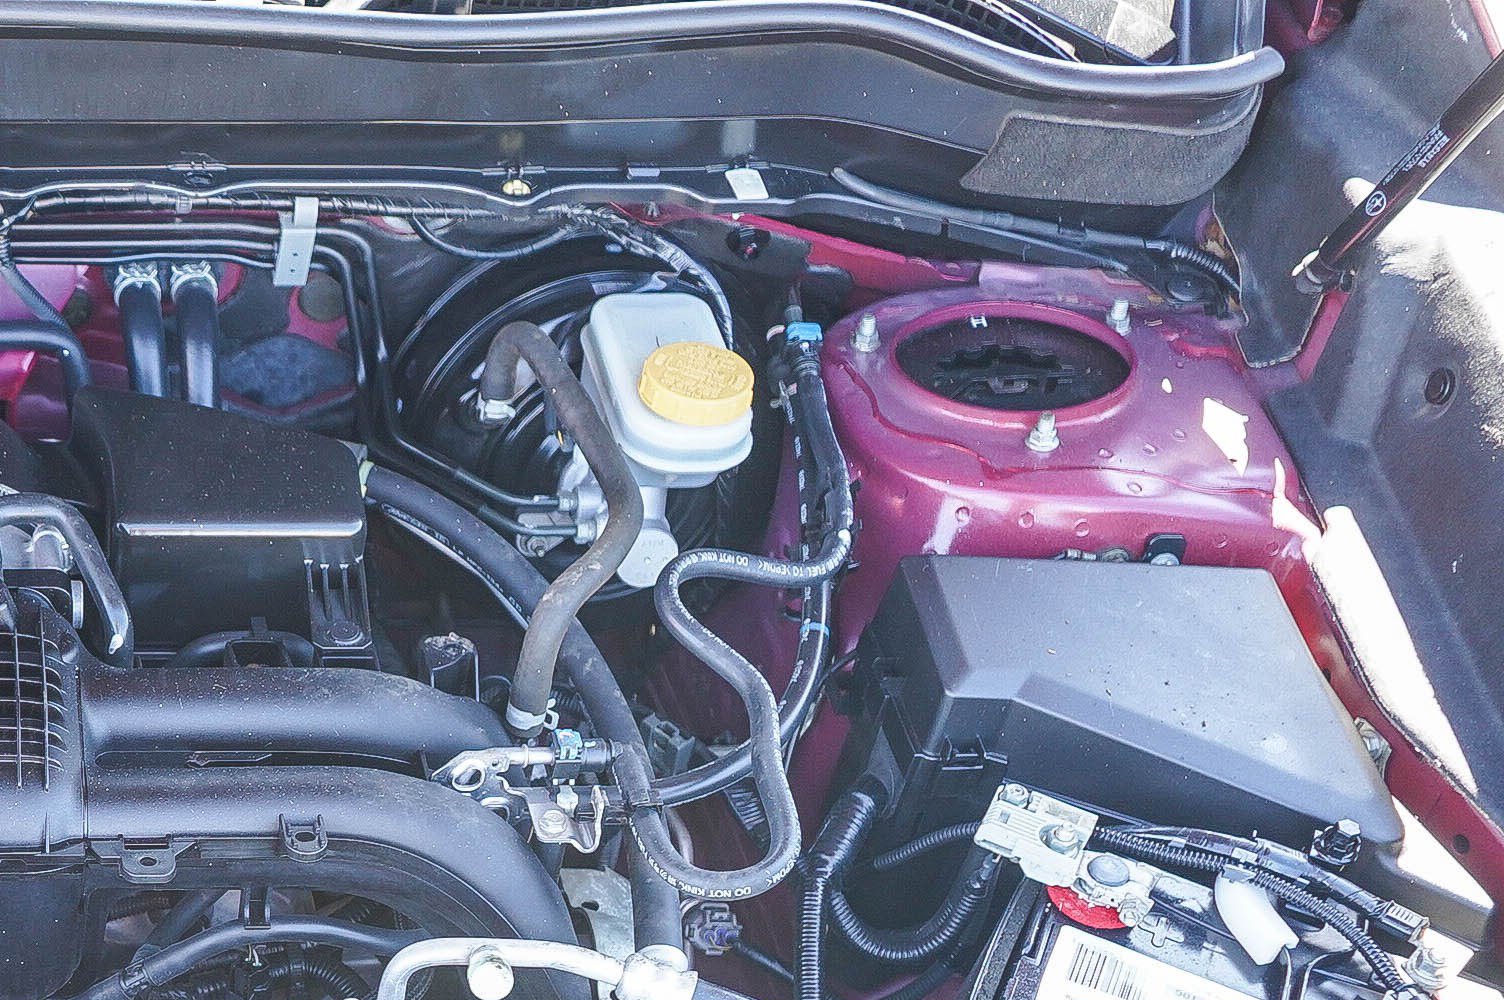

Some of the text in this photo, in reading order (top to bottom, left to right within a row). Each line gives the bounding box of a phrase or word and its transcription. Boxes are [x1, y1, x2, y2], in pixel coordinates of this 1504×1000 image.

[718, 551, 735, 563] NOT
[736, 554, 749, 566] DO
[708, 889, 732, 898] NOT
[734, 886, 752, 897] DO
